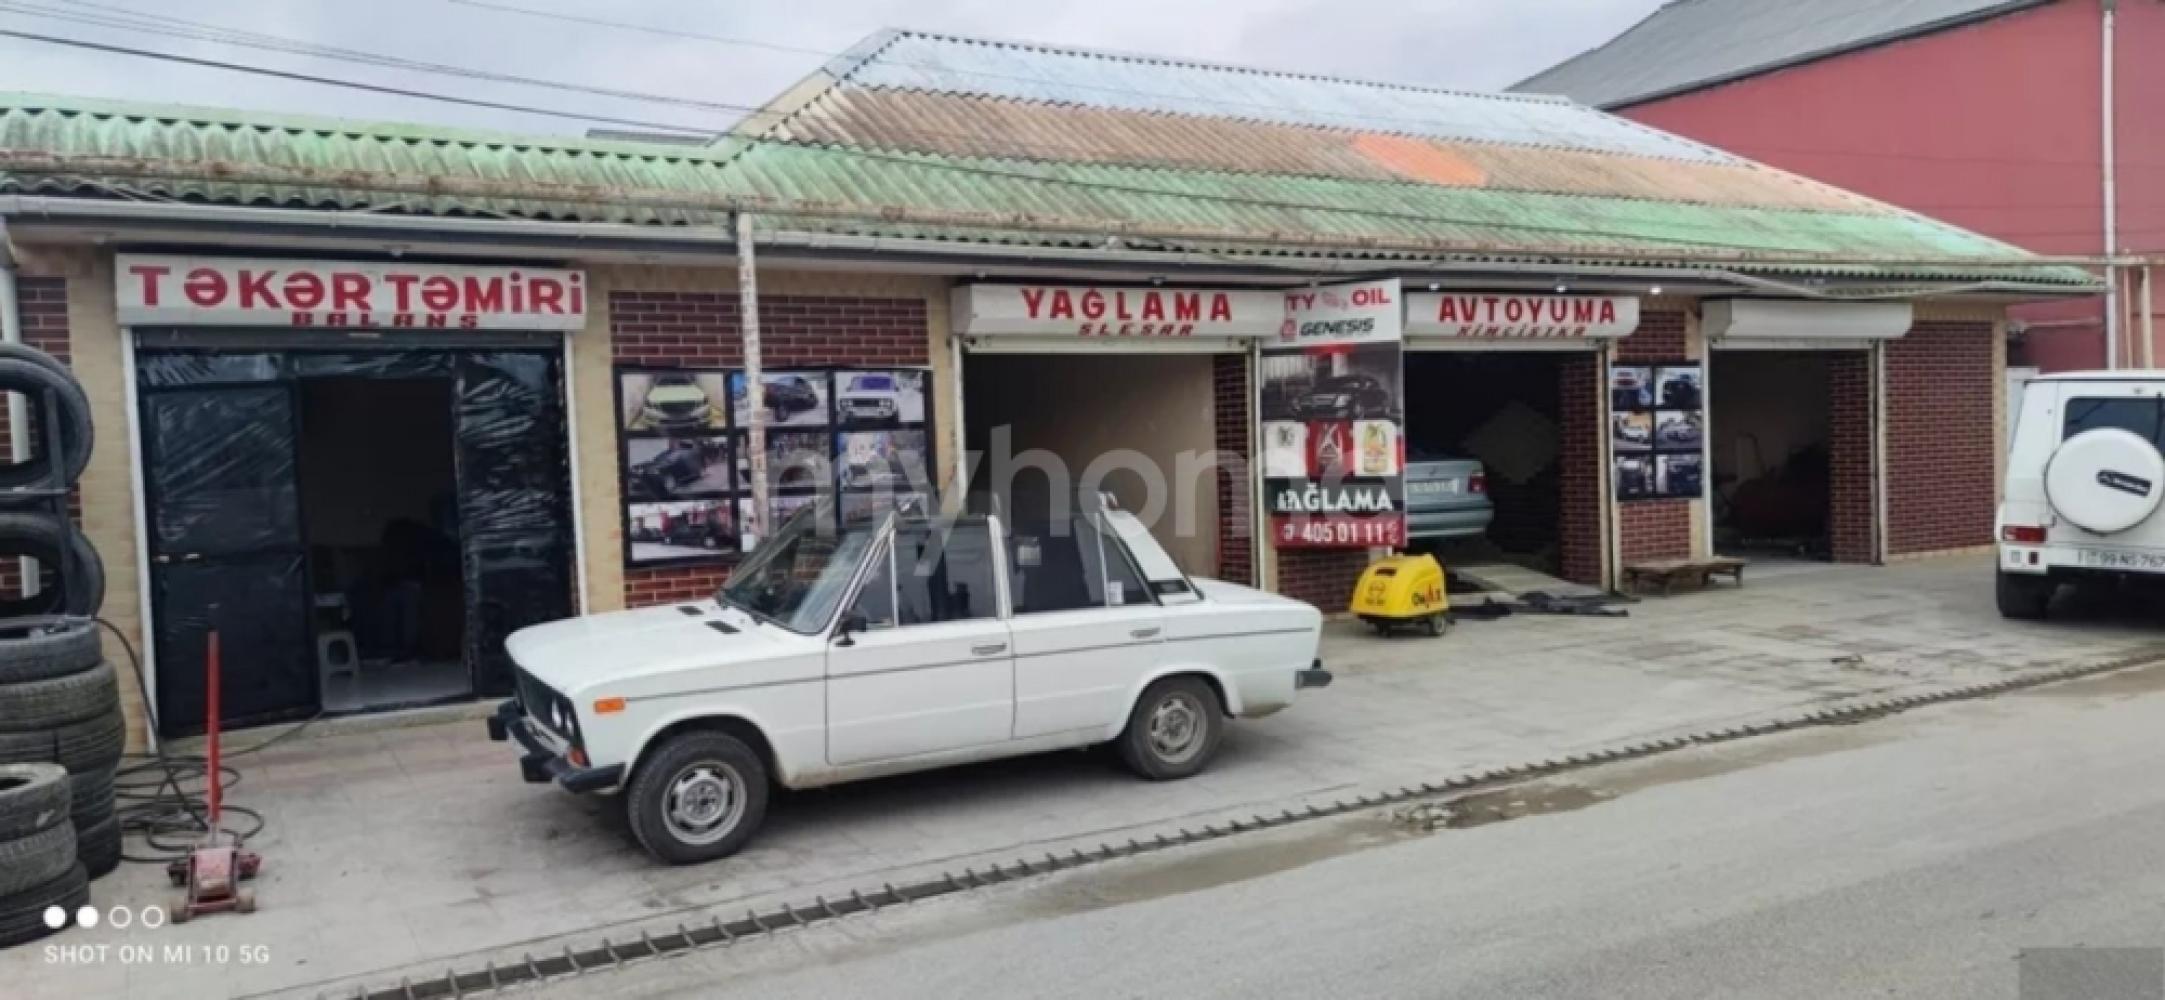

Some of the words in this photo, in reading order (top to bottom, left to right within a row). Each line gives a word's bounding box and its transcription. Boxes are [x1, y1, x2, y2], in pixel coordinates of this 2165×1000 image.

[129, 265, 372, 310] TƏKƏR
[384, 271, 583, 315] TƏMİRİ
[1352, 287, 1392, 306] OIL
[1021, 287, 1233, 321] YAĞLAMA
[1439, 296, 1616, 323] AVTOYUMA
[291, 312, 479, 329] BALANS
[1078, 322, 1194, 337] SLESAR
[1300, 317, 1375, 336] GENESIS
[1302, 523, 1334, 543] 405
[1337, 523, 1359, 543] 01
[1364, 523, 1385, 543] 11
